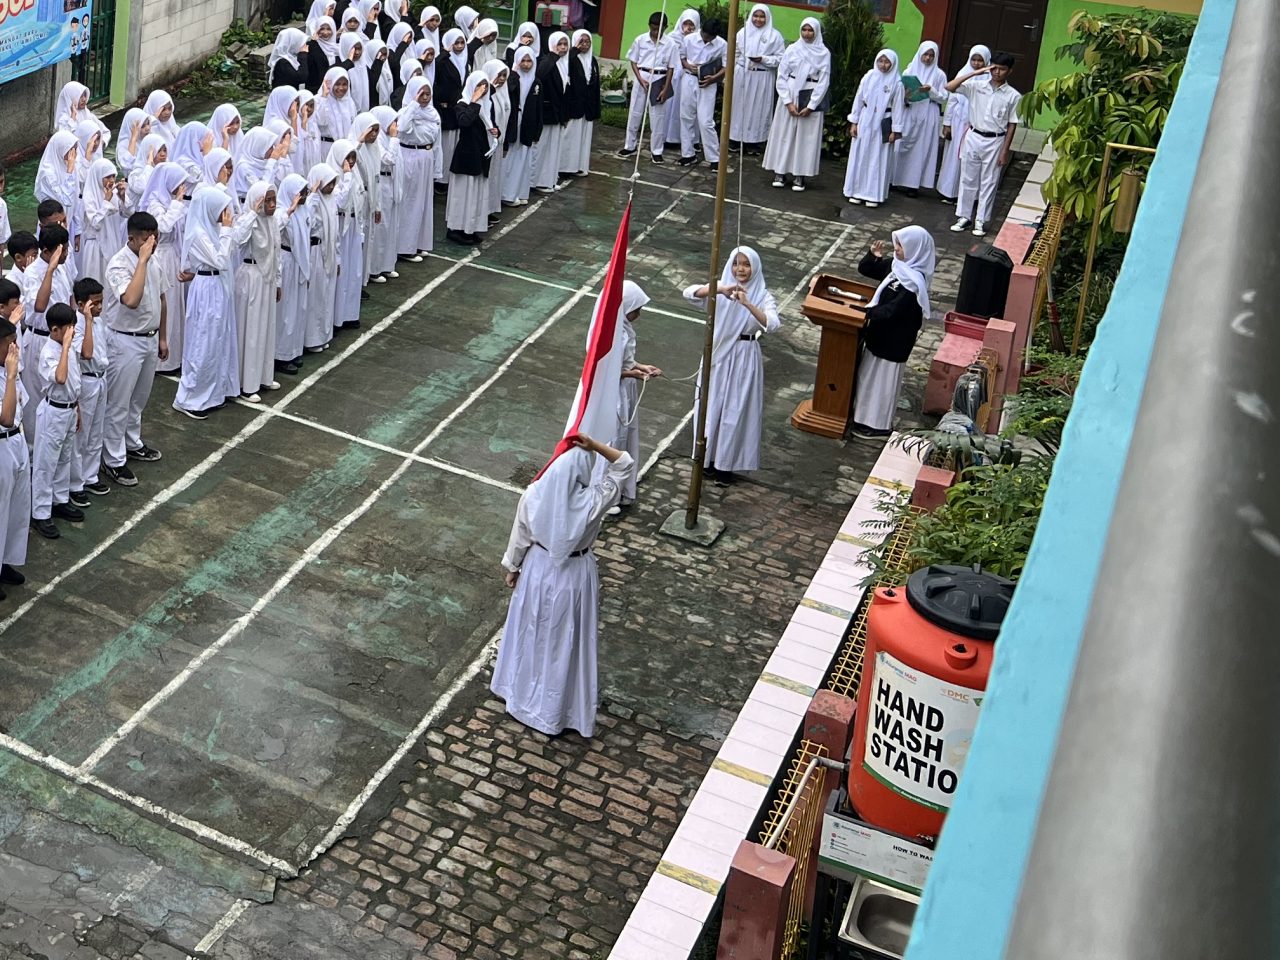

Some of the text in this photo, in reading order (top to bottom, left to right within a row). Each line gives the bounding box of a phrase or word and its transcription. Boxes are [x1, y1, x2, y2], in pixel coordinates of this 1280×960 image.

[877, 677, 945, 733] HAND
[947, 689, 970, 701] DMC
[875, 703, 944, 763] WASH
[871, 732, 958, 794] STATIO
[893, 844, 908, 854] HOW
